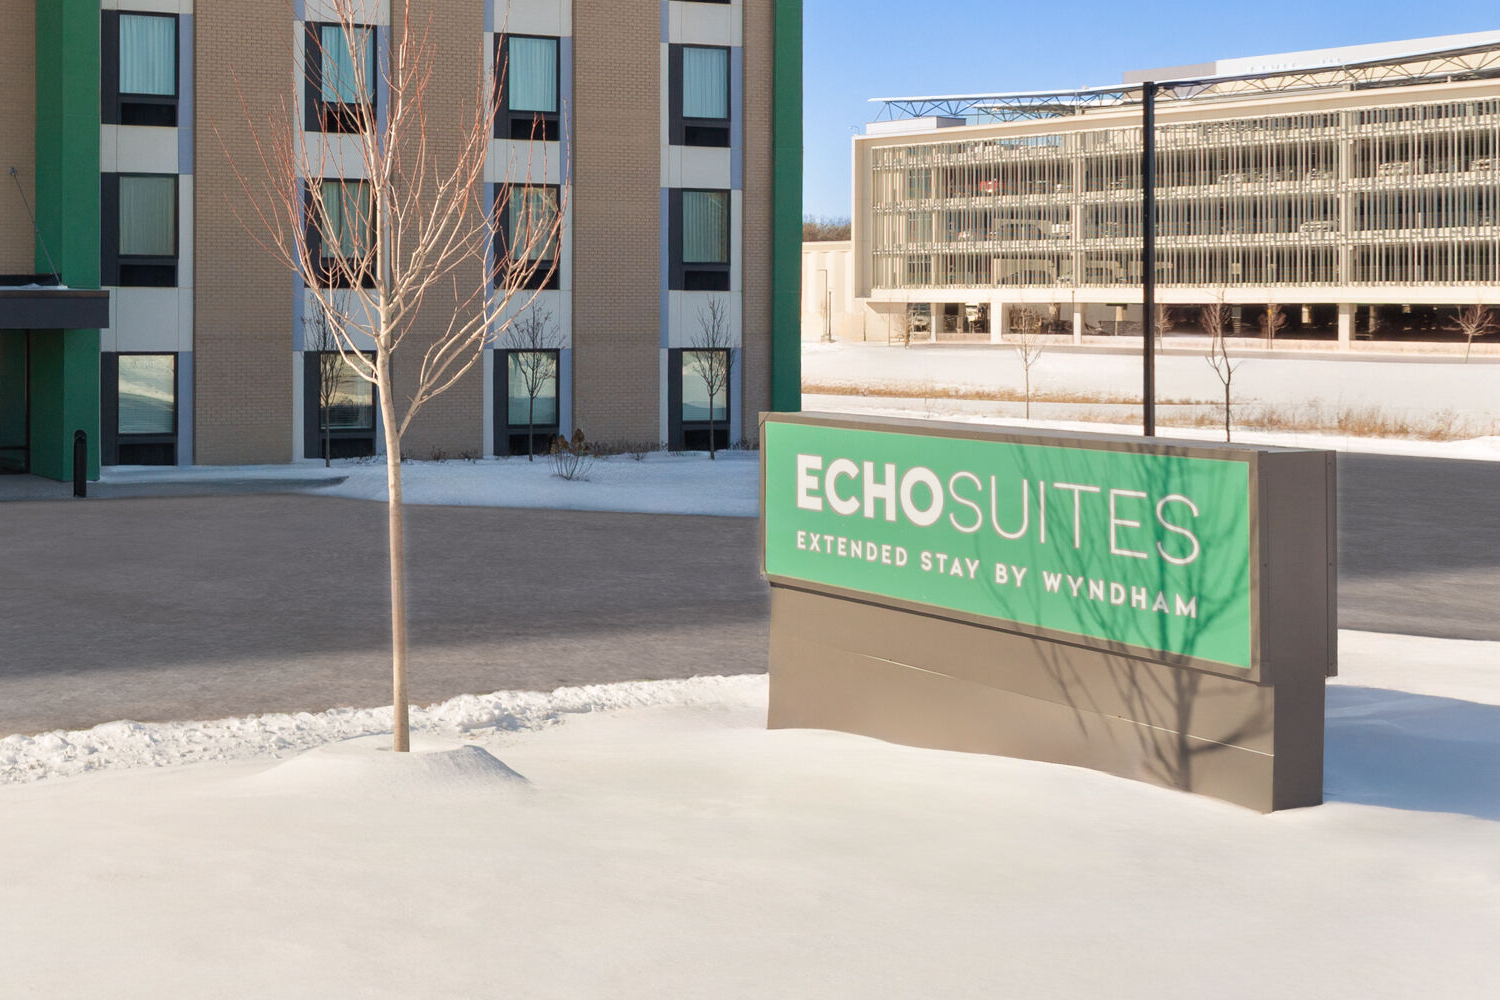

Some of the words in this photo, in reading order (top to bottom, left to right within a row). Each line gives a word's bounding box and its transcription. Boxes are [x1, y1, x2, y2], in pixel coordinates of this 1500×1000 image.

[797, 454, 1200, 565] ECHOSUITES
[797, 531, 908, 566] EXTENDED
[921, 551, 980, 579] STAY
[995, 563, 1027, 587] BY
[1042, 570, 1197, 618] WYNDHAM
